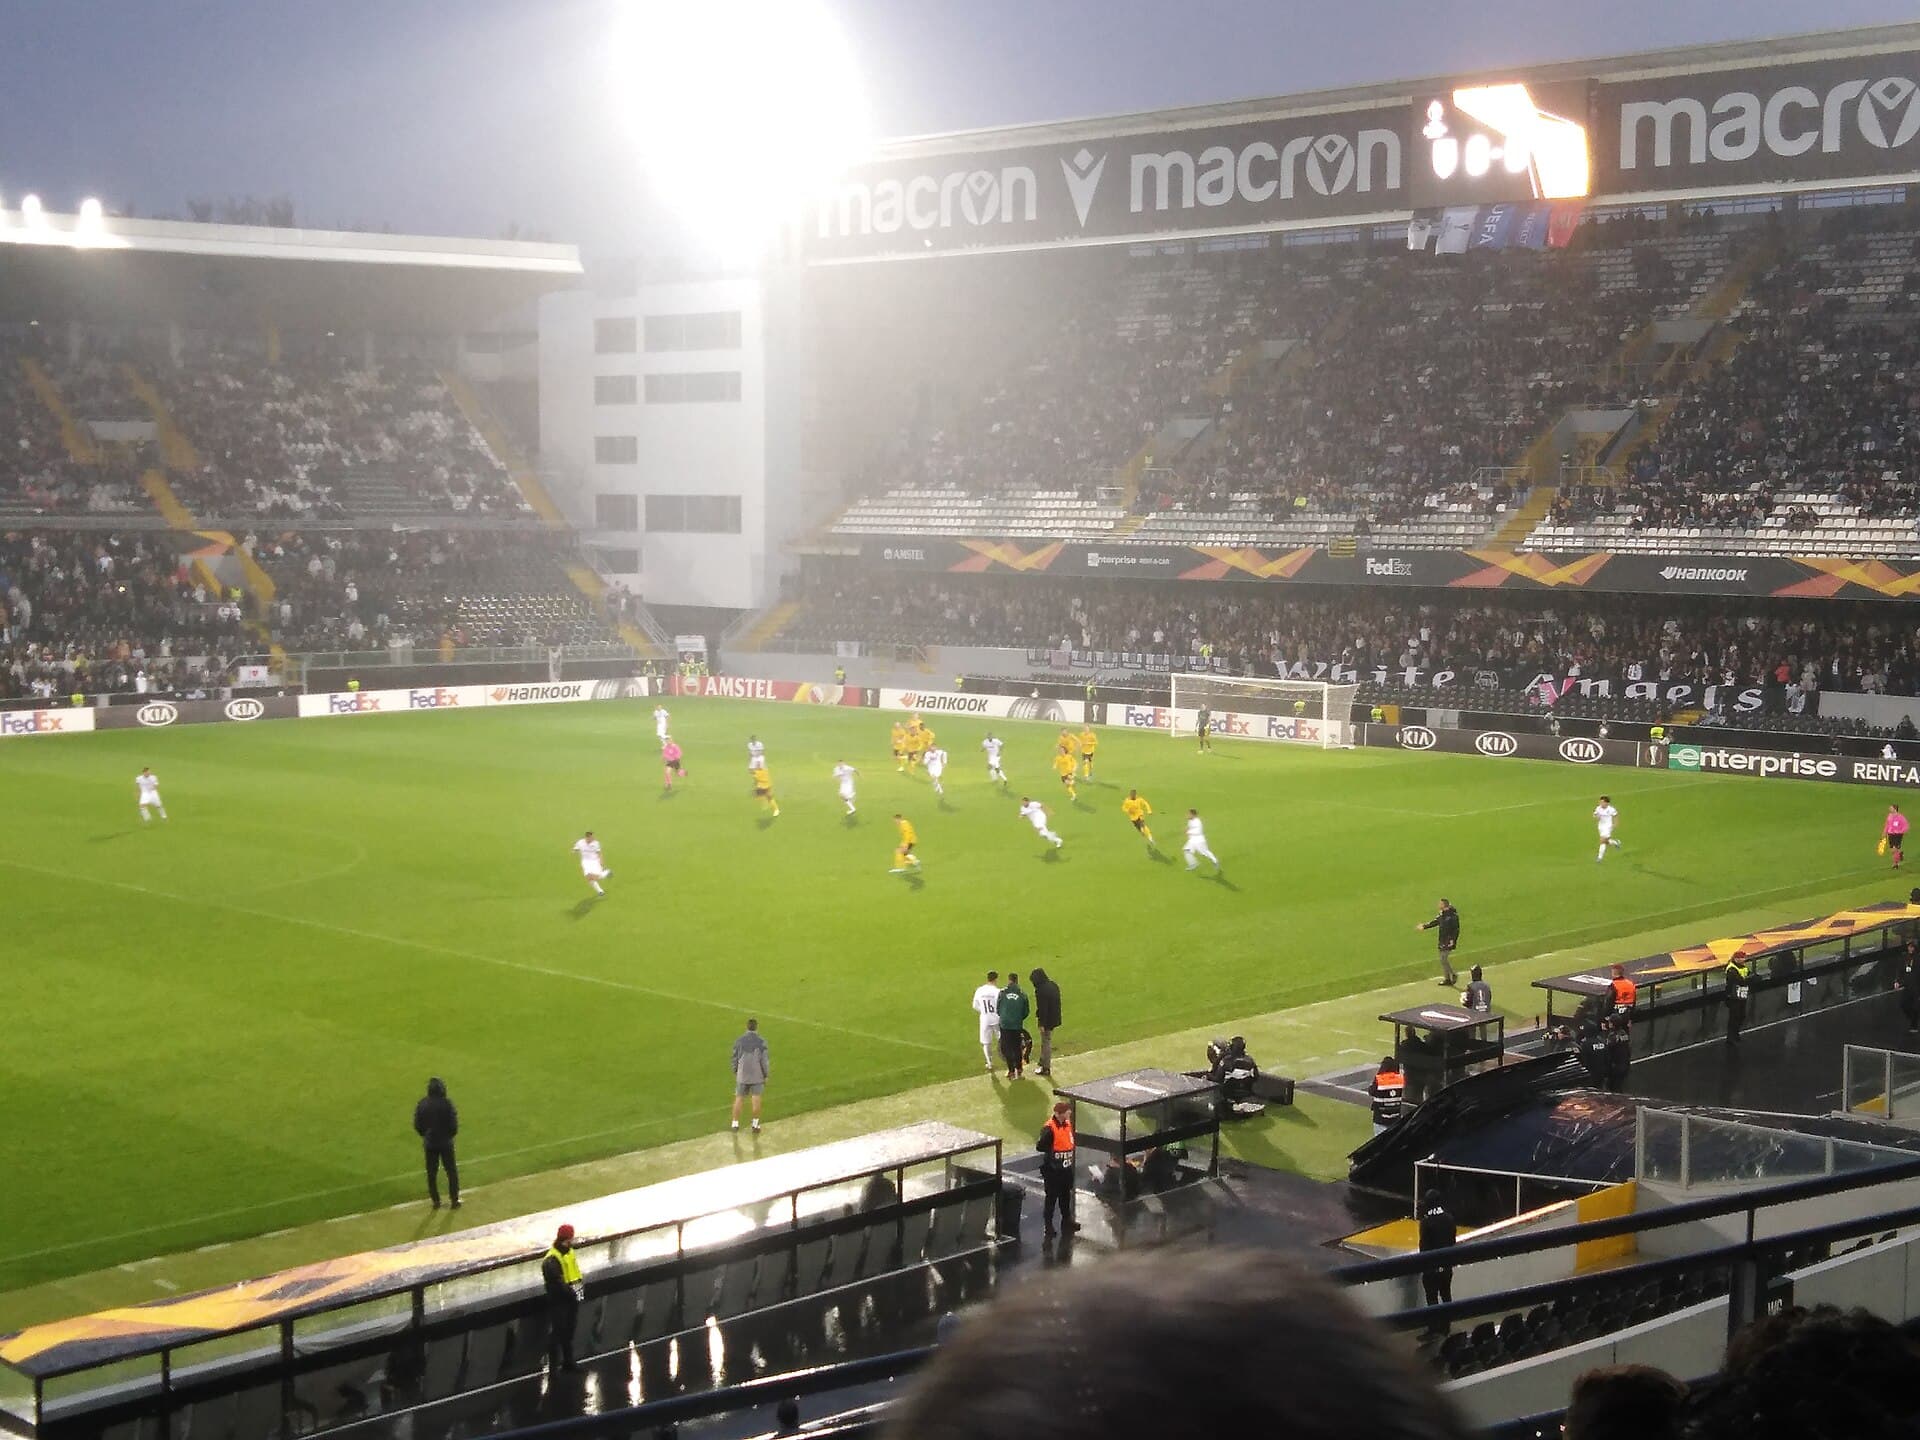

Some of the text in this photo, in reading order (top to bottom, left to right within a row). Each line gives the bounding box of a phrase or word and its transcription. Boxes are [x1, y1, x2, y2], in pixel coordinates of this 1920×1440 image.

[1130, 128, 1400, 213] macron
[817, 166, 1037, 238] macron
[1088, 552, 1136, 566] nterprise
[1366, 558, 1412, 576] FedEx
[704, 676, 776, 700] AMSTEL
[329, 694, 381, 713] FedEx
[409, 689, 459, 708] FedEx
[143, 708, 170, 722] KIA
[231, 702, 258, 716] KIA
[1125, 706, 1180, 729] FedEx
[1, 711, 63, 734] FedEx
[1210, 713, 1250, 735] edEx
[1267, 717, 1320, 741] FedEx
[1403, 729, 1430, 746] KIA
[1482, 736, 1511, 752] KIA
[1566, 742, 1597, 758] KIA
[1672, 747, 1838, 777] enterprise
[982, 999, 995, 1014] 16
